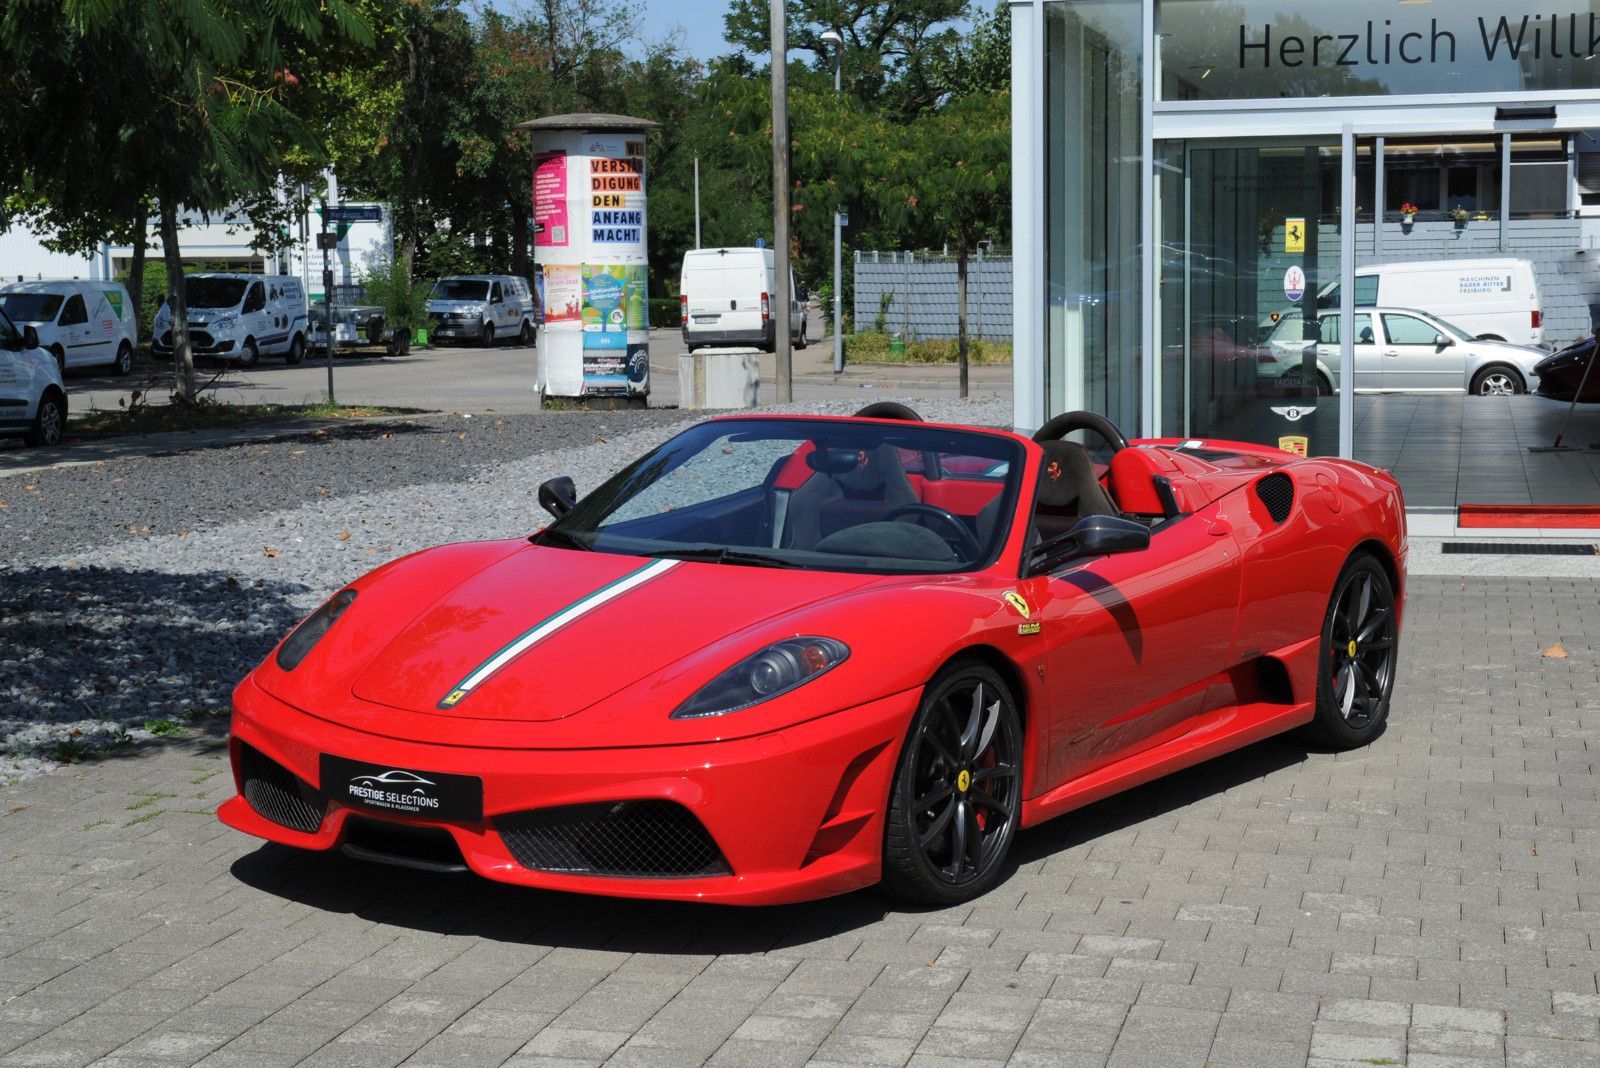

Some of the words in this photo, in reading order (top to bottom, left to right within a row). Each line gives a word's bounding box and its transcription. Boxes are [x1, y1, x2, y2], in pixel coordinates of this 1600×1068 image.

[1239, 18, 1456, 68] Herzlich
[592, 177, 640, 190] DIGUNG
[593, 195, 620, 206] DEN
[592, 211, 641, 224] ANFANG
[593, 228, 640, 241] MACHT.
[349, 785, 385, 800] PRESTIGE
[386, 792, 439, 808] SELECTIONS
[364, 799, 390, 808] SPORTWAGEN
[395, 804, 419, 812] KLASSIKER
